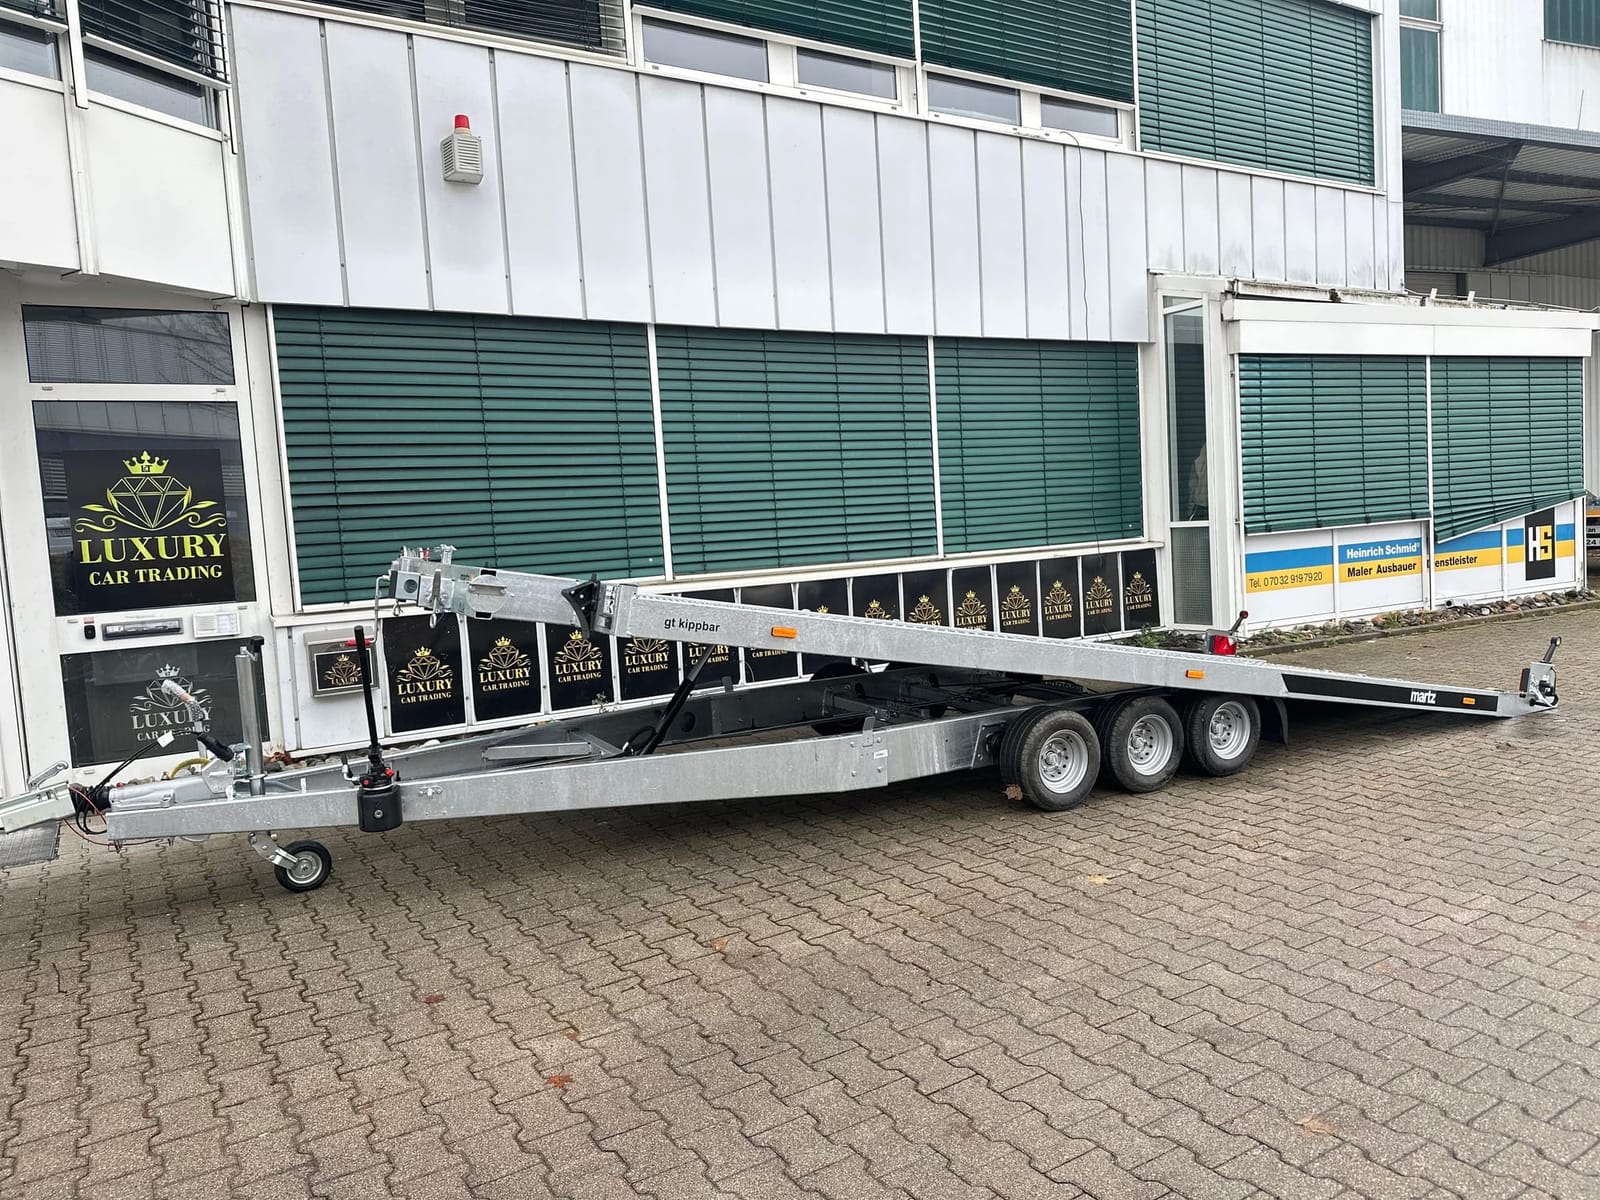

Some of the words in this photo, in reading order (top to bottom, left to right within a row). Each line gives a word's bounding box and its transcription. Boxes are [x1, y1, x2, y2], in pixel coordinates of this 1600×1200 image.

[77, 533, 226, 564] LUXURY
[1528, 525, 1552, 562] HS
[1346, 545, 1384, 559] Heinrich
[1347, 566, 1373, 578] Maler
[1376, 562, 1417, 575] Ausbauer
[1426, 555, 1478, 569] Denstleister
[89, 570, 131, 586] CAR
[134, 564, 223, 583] TRADING
[1085, 598, 1113, 609] LUXURY
[1125, 593, 1152, 604] LUXURY
[1001, 609, 1030, 620] LUXURY
[1044, 603, 1072, 615] LUXURY
[664, 618, 677, 629] gt
[678, 618, 721, 633] kippbar
[956, 615, 987, 626] LUXURY
[624, 651, 669, 667] LUXURY
[555, 659, 602, 675] LUXURY
[627, 666, 641, 674] CAR
[641, 663, 668, 673] TRADING
[479, 667, 531, 683] LUXURY
[558, 674, 572, 683] CAR
[572, 671, 602, 681] TRADING
[397, 678, 454, 695] LUXURY
[482, 684, 498, 692] CAR
[498, 680, 530, 690] TRADING
[400, 694, 417, 704] CAR
[418, 691, 452, 702] TRADING
[1410, 690, 1437, 704] martz
[136, 730, 159, 741] CAR
